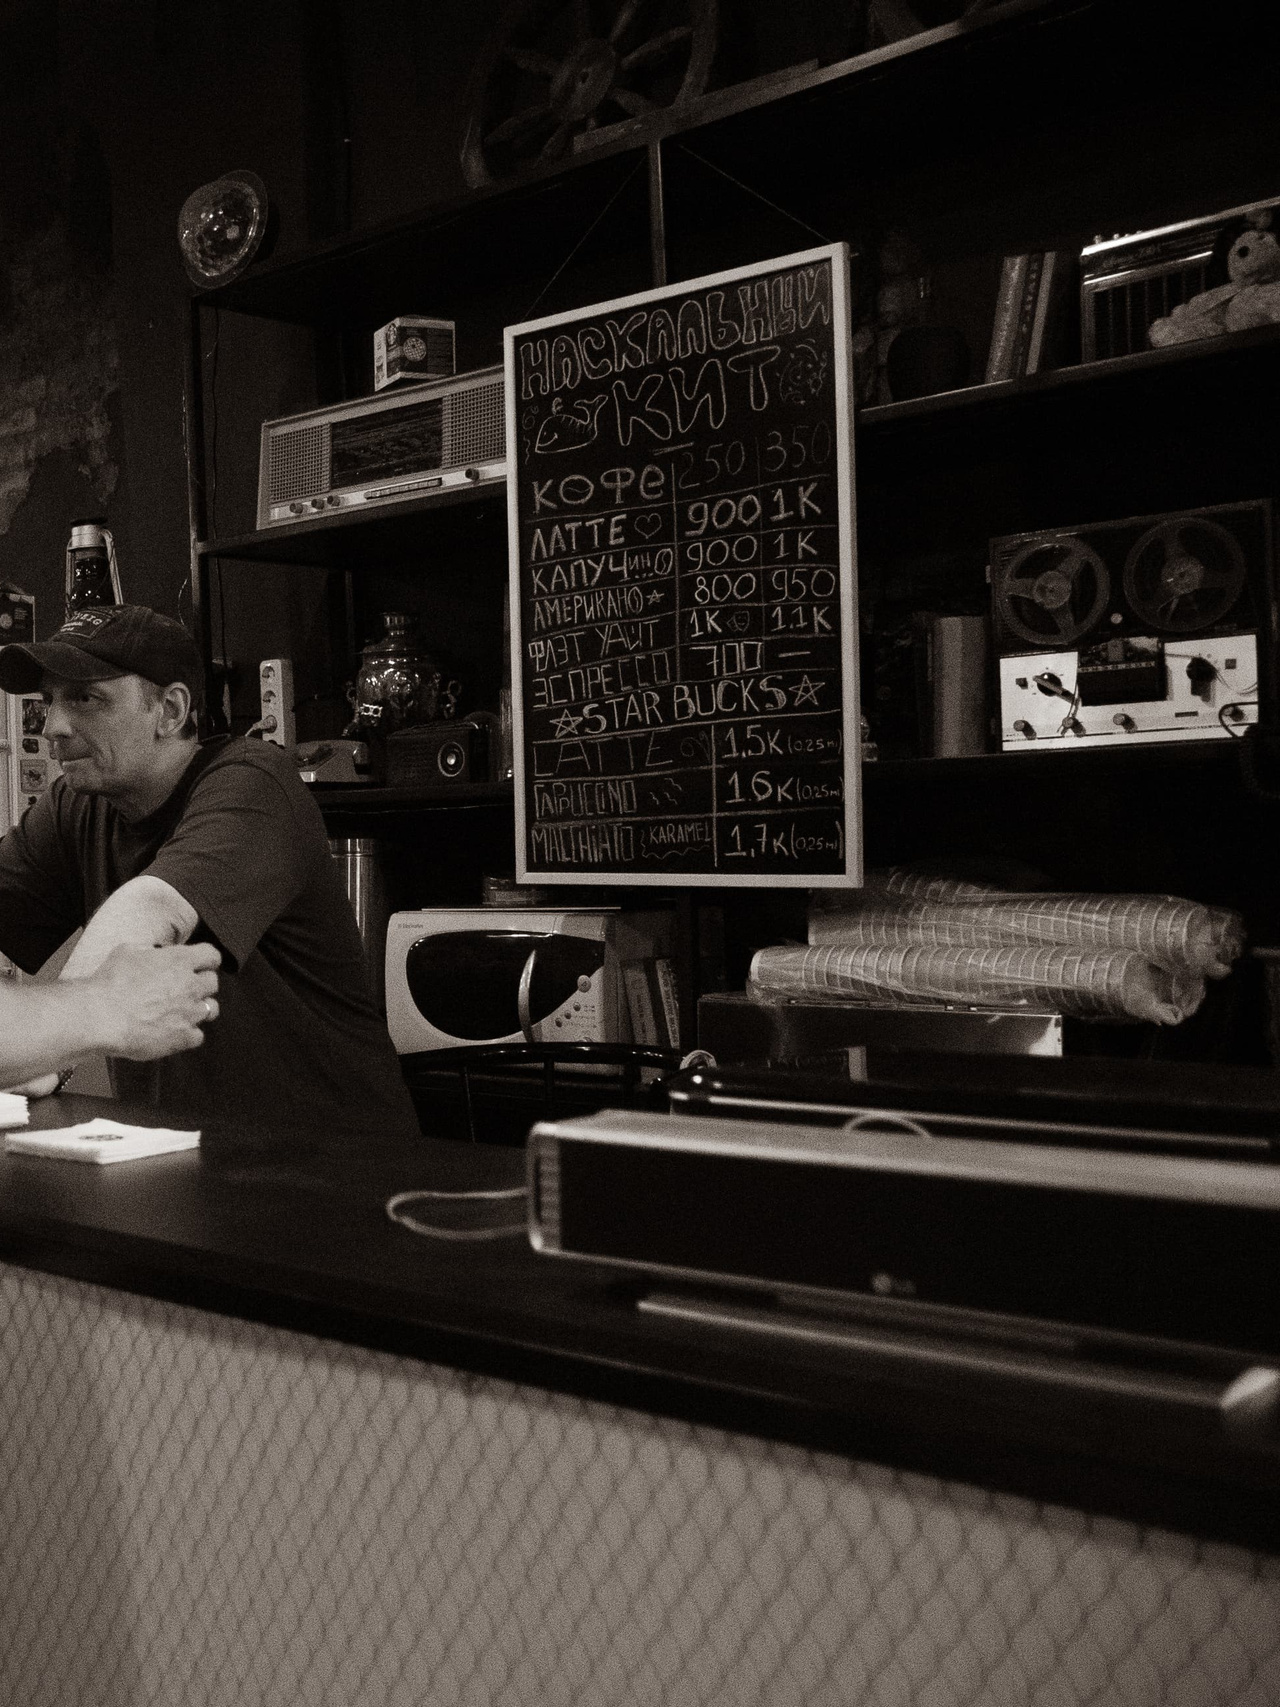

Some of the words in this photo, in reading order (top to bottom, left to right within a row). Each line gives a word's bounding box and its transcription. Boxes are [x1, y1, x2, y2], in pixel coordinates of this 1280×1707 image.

[612, 346, 781, 446] КИТ
[679, 441, 746, 489] 250
[764, 421, 832, 472] 350
[531, 514, 627, 561] ЛАТТЕ
[684, 494, 762, 537] 900
[686, 535, 758, 572] 900
[533, 586, 644, 631] АМЕРИКАНО
[694, 572, 756, 604] 800
[769, 568, 836, 603] 950
[528, 631, 585, 673] ФЛЭТ
[595, 619, 661, 658] УАЙТ
[532, 651, 671, 708] ЭСПРЕССО
[689, 641, 763, 676] 700
[583, 690, 663, 735] STAR
[673, 675, 787, 721] BUCKS
[533, 729, 673, 777] LATTE
[650, 822, 712, 844] KARAMEL
